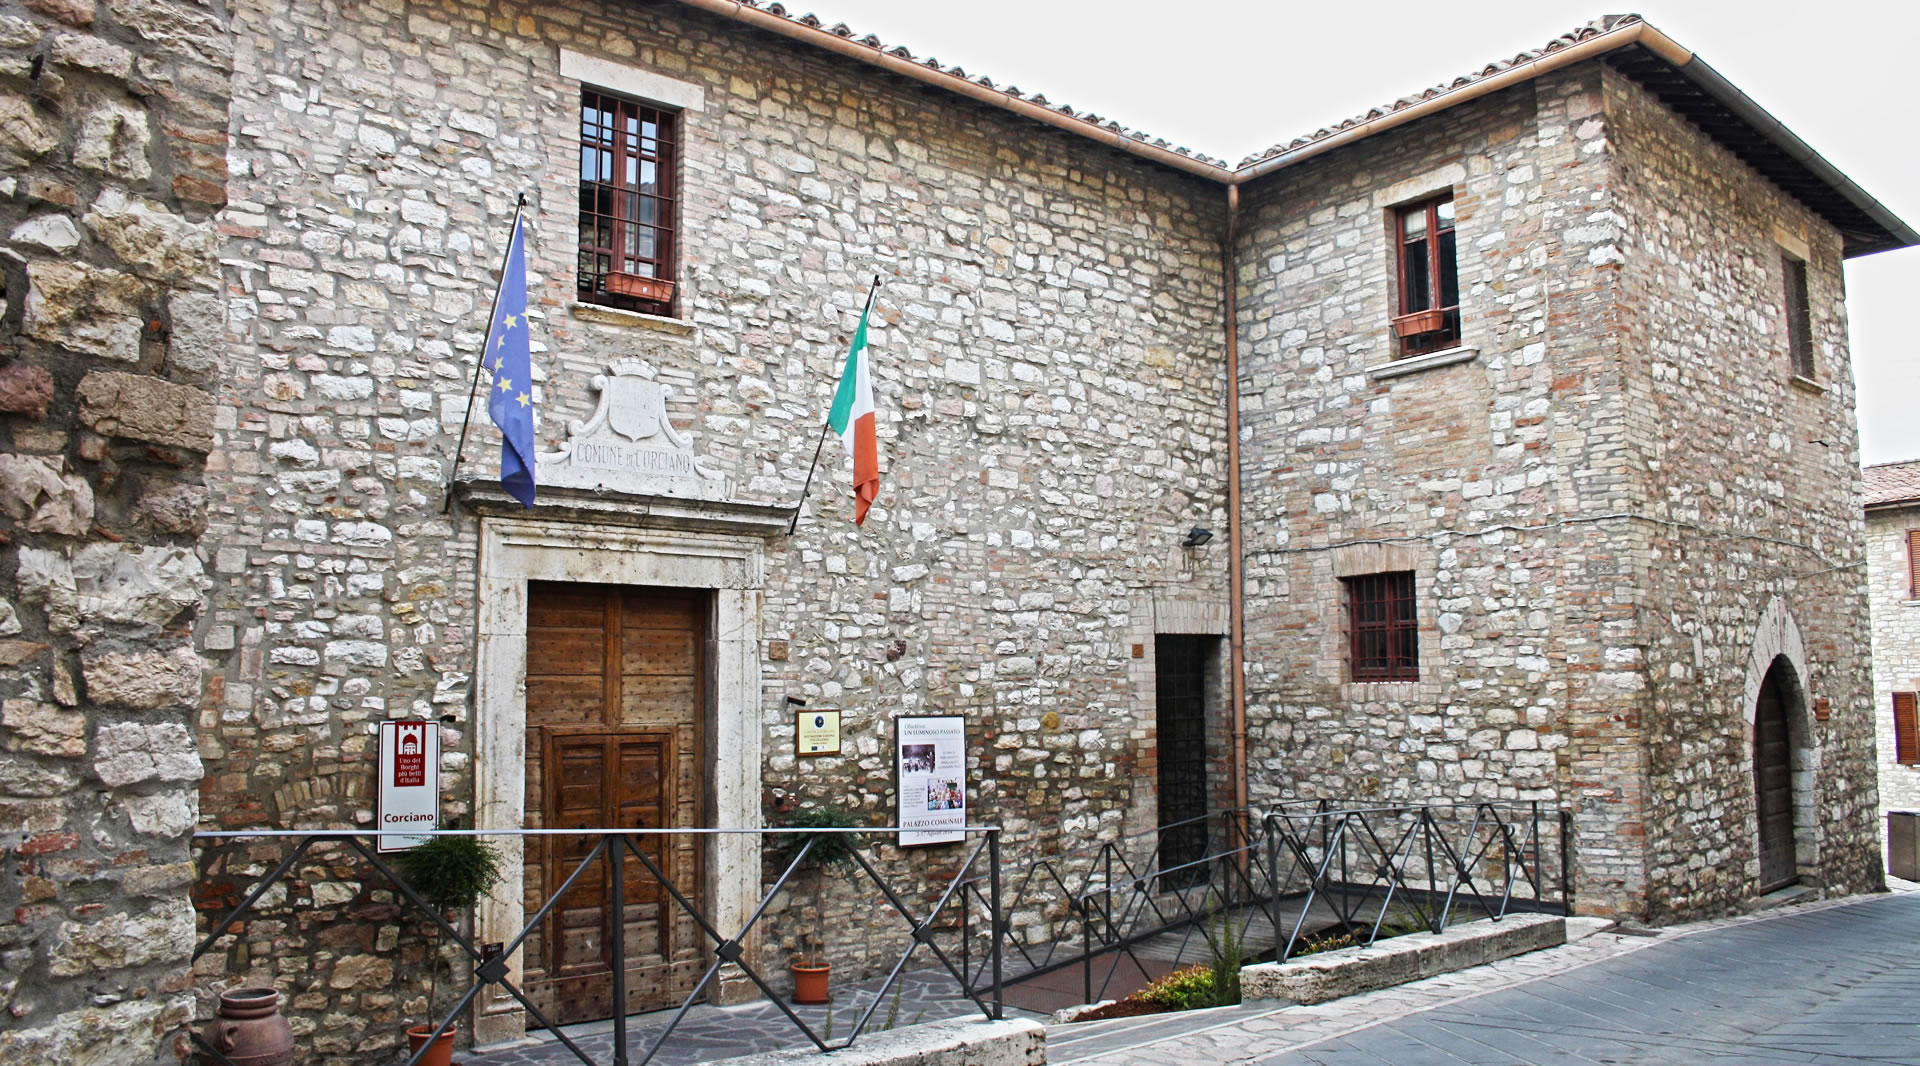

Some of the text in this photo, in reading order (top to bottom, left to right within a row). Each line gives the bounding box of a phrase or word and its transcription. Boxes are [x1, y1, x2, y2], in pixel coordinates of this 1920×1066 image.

[576, 443, 623, 465] COMUNE
[635, 449, 690, 474] CORCIANO
[384, 812, 434, 823] Corciano
[903, 817, 963, 828] PALAZZO COMUNALE
